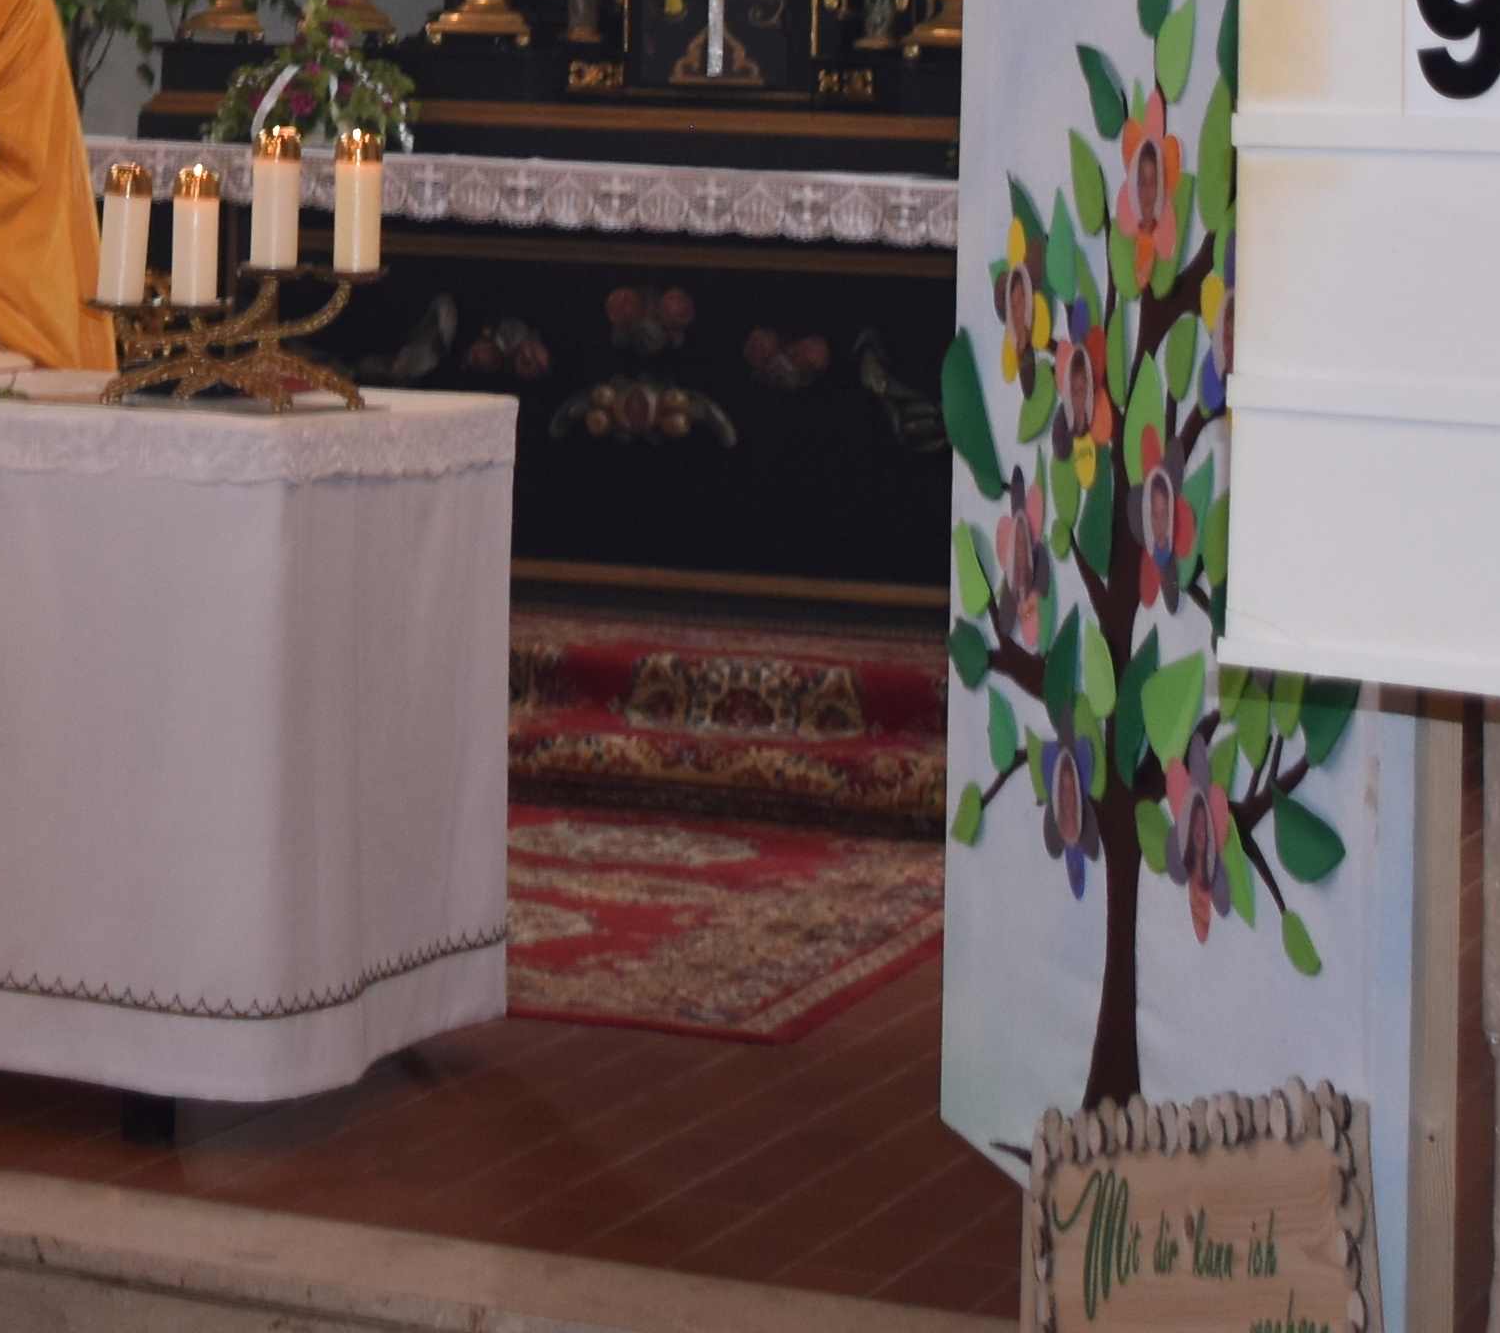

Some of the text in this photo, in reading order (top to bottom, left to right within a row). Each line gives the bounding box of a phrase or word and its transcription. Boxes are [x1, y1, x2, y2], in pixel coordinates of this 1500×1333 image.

[1052, 1170, 1277, 1321] Mit dir kann ich
